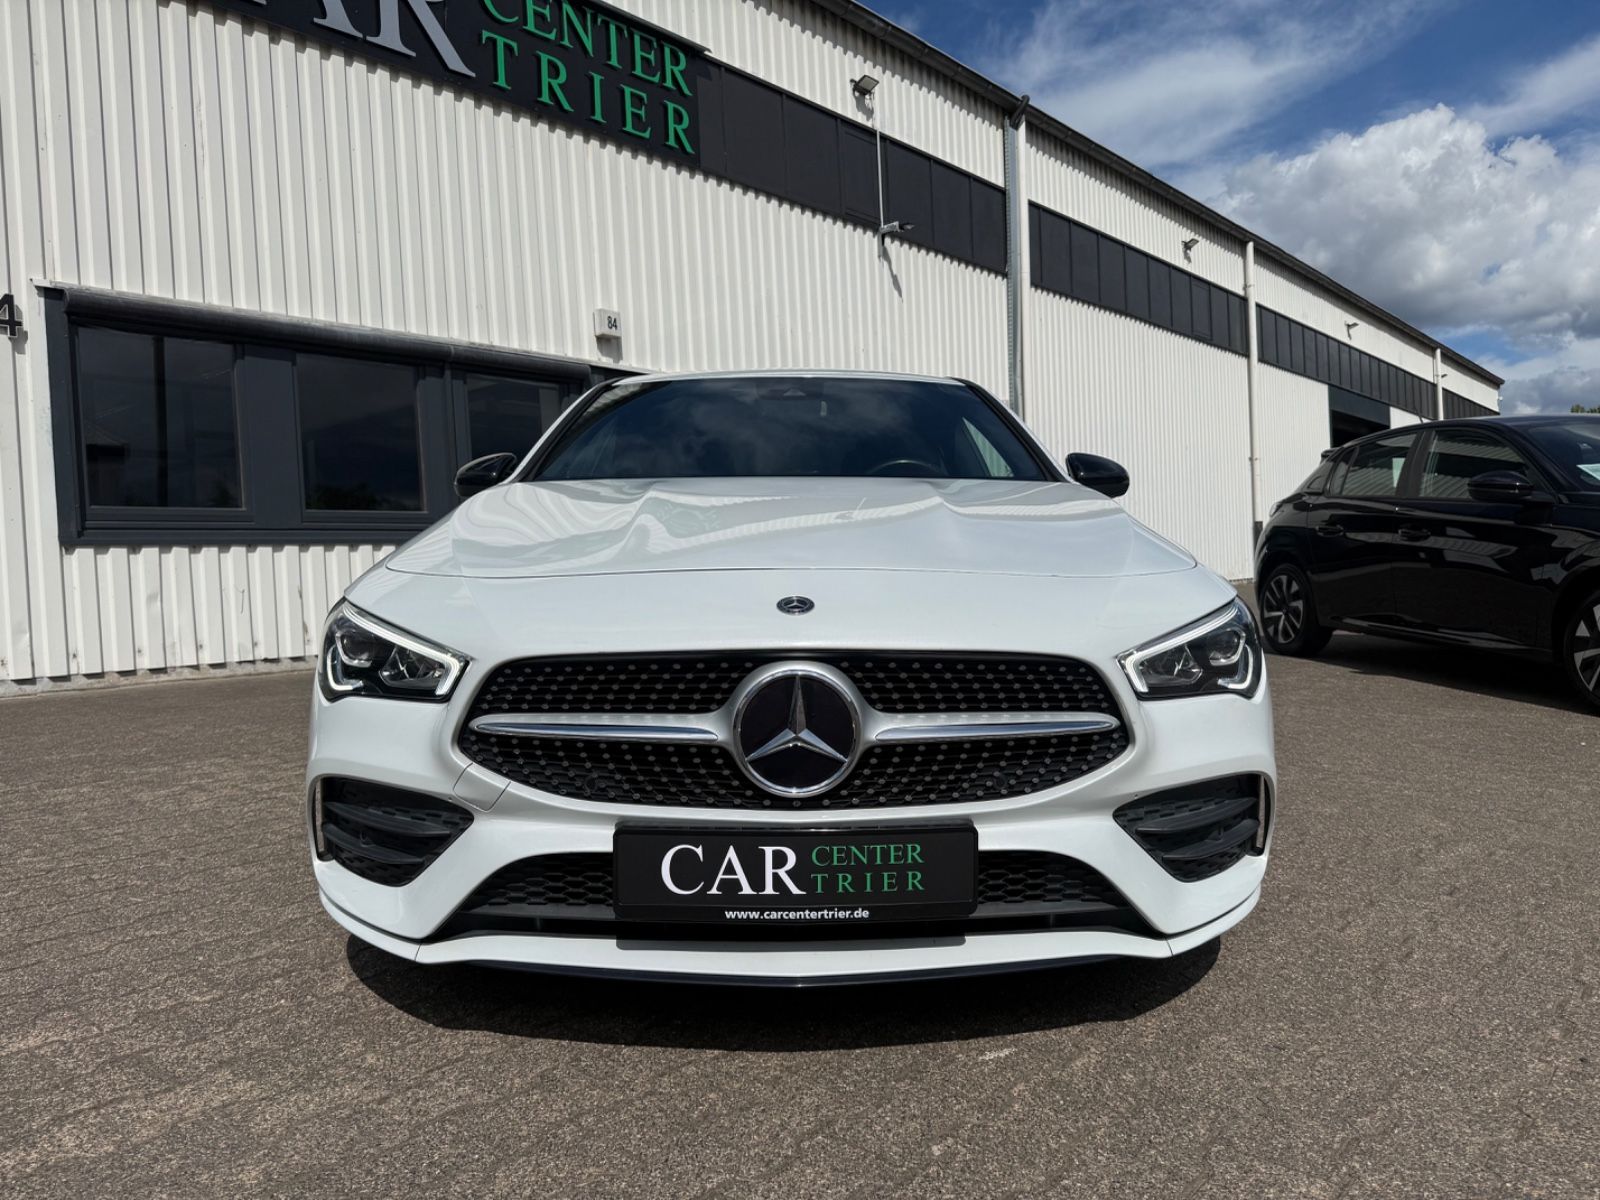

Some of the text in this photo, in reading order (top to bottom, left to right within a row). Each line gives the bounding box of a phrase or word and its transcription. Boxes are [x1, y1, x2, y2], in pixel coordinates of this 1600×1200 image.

[482, 30, 695, 154] TRIER
[607, 315, 618, 330] 84
[811, 843, 924, 866] CENTER
[661, 844, 806, 895] CAR
[811, 871, 924, 893] TRIER
[725, 907, 870, 920] www.carcentertrier.de
